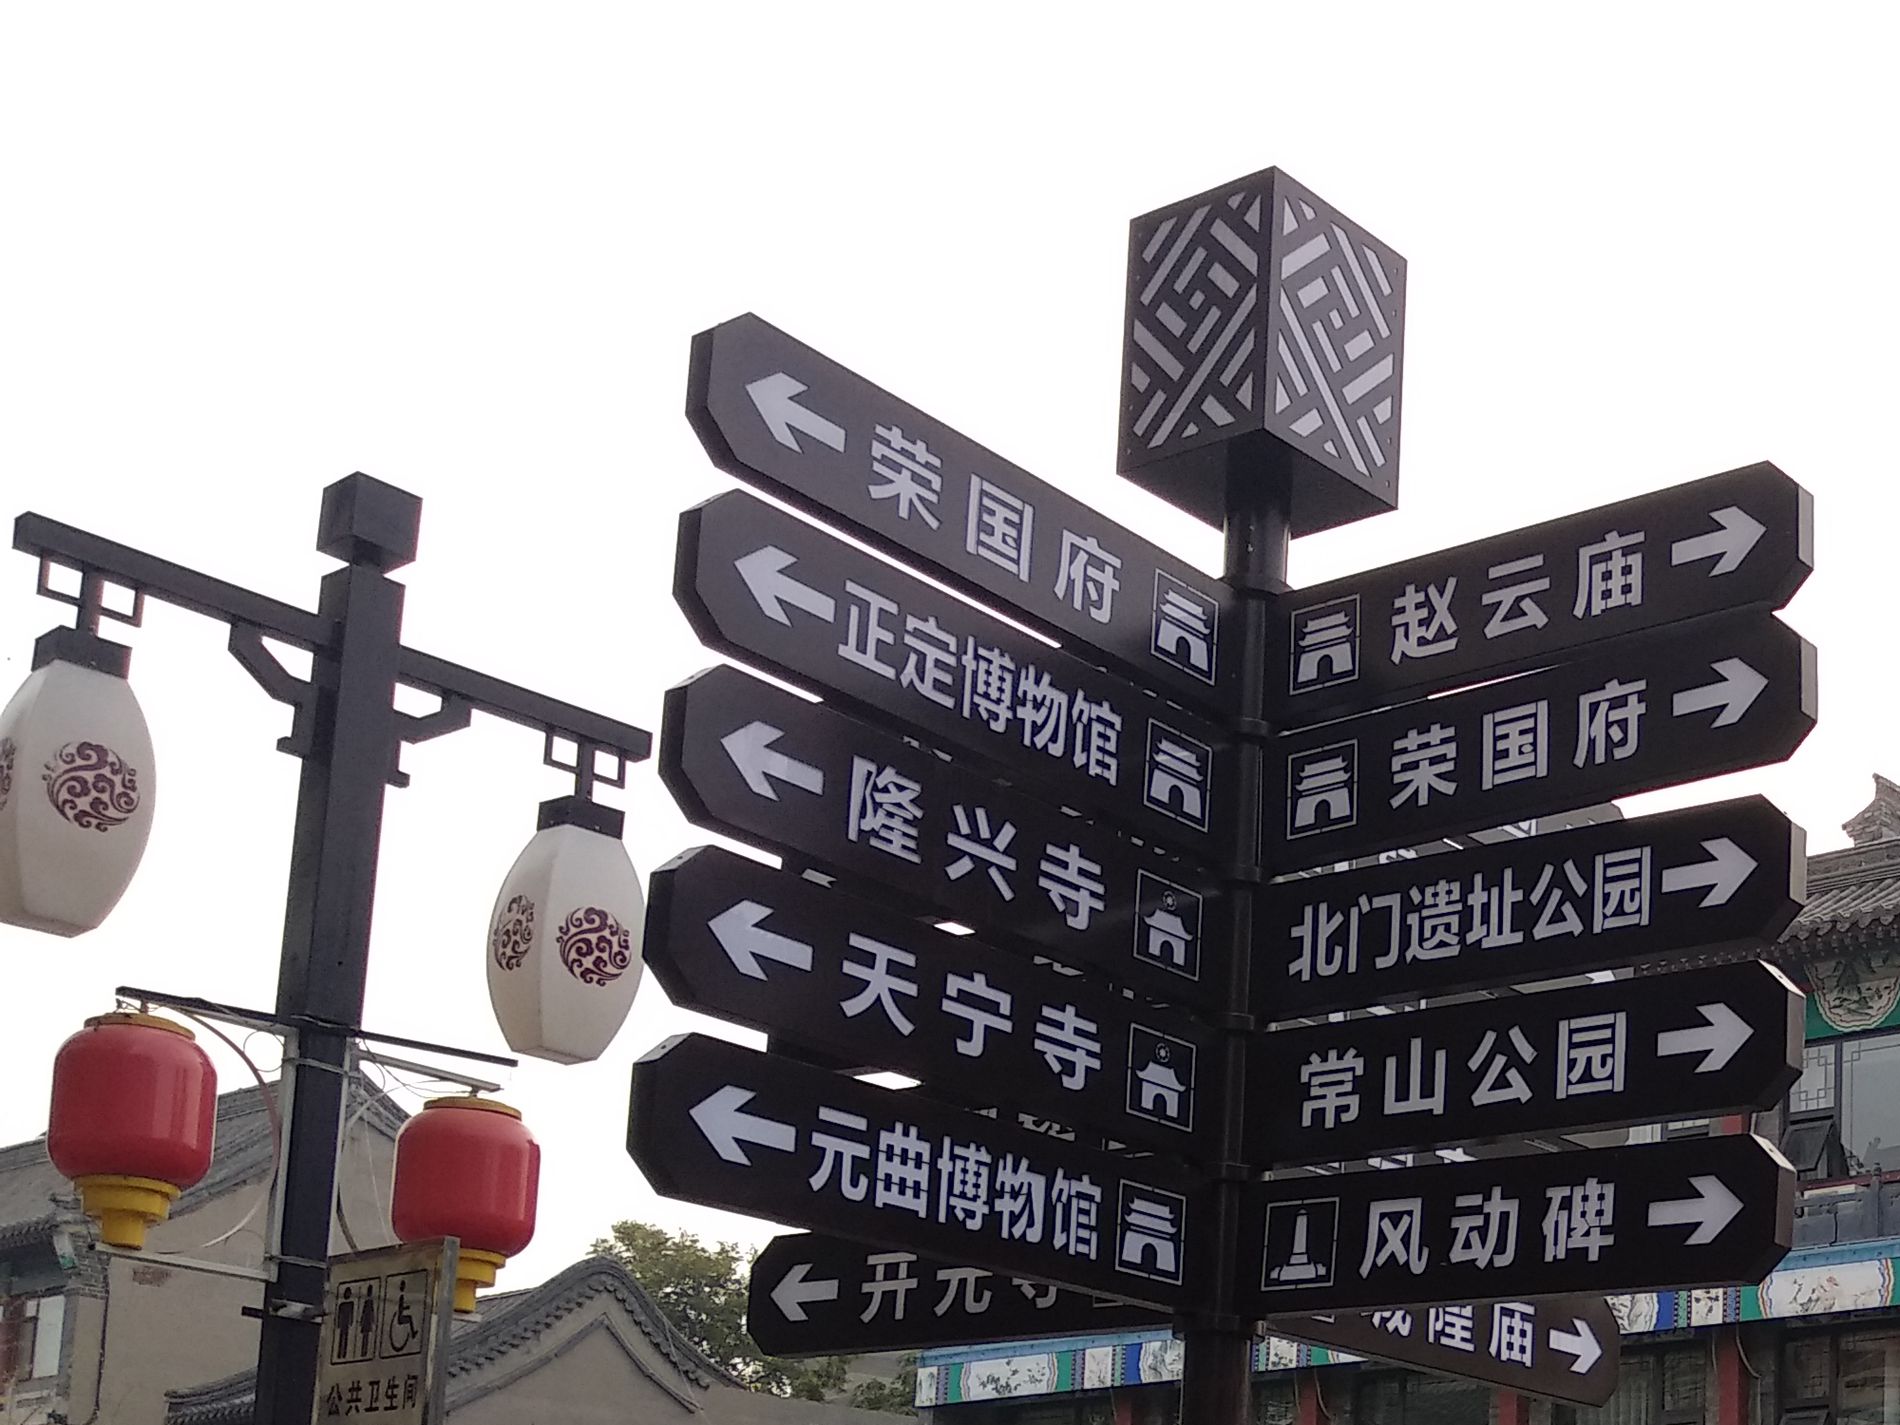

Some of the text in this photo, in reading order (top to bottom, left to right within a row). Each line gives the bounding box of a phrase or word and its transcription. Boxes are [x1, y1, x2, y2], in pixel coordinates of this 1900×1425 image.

[868, 423, 1123, 624] 荣国府
[1389, 530, 1646, 666] 赵云庙
[838, 578, 1123, 787] 正定博物馆
[1389, 677, 1648, 810] 荣国府
[848, 755, 1106, 931] 隆兴寺
[1287, 846, 1652, 982] 北门遗址公园
[839, 932, 1101, 1092] 天宁寺
[1299, 1011, 1628, 1129] 常山公园
[809, 1105, 1101, 1260] 元曲博物馆
[1359, 1177, 1616, 1280] 风动碑
[326, 1374, 418, 1417] 公共卫生间
